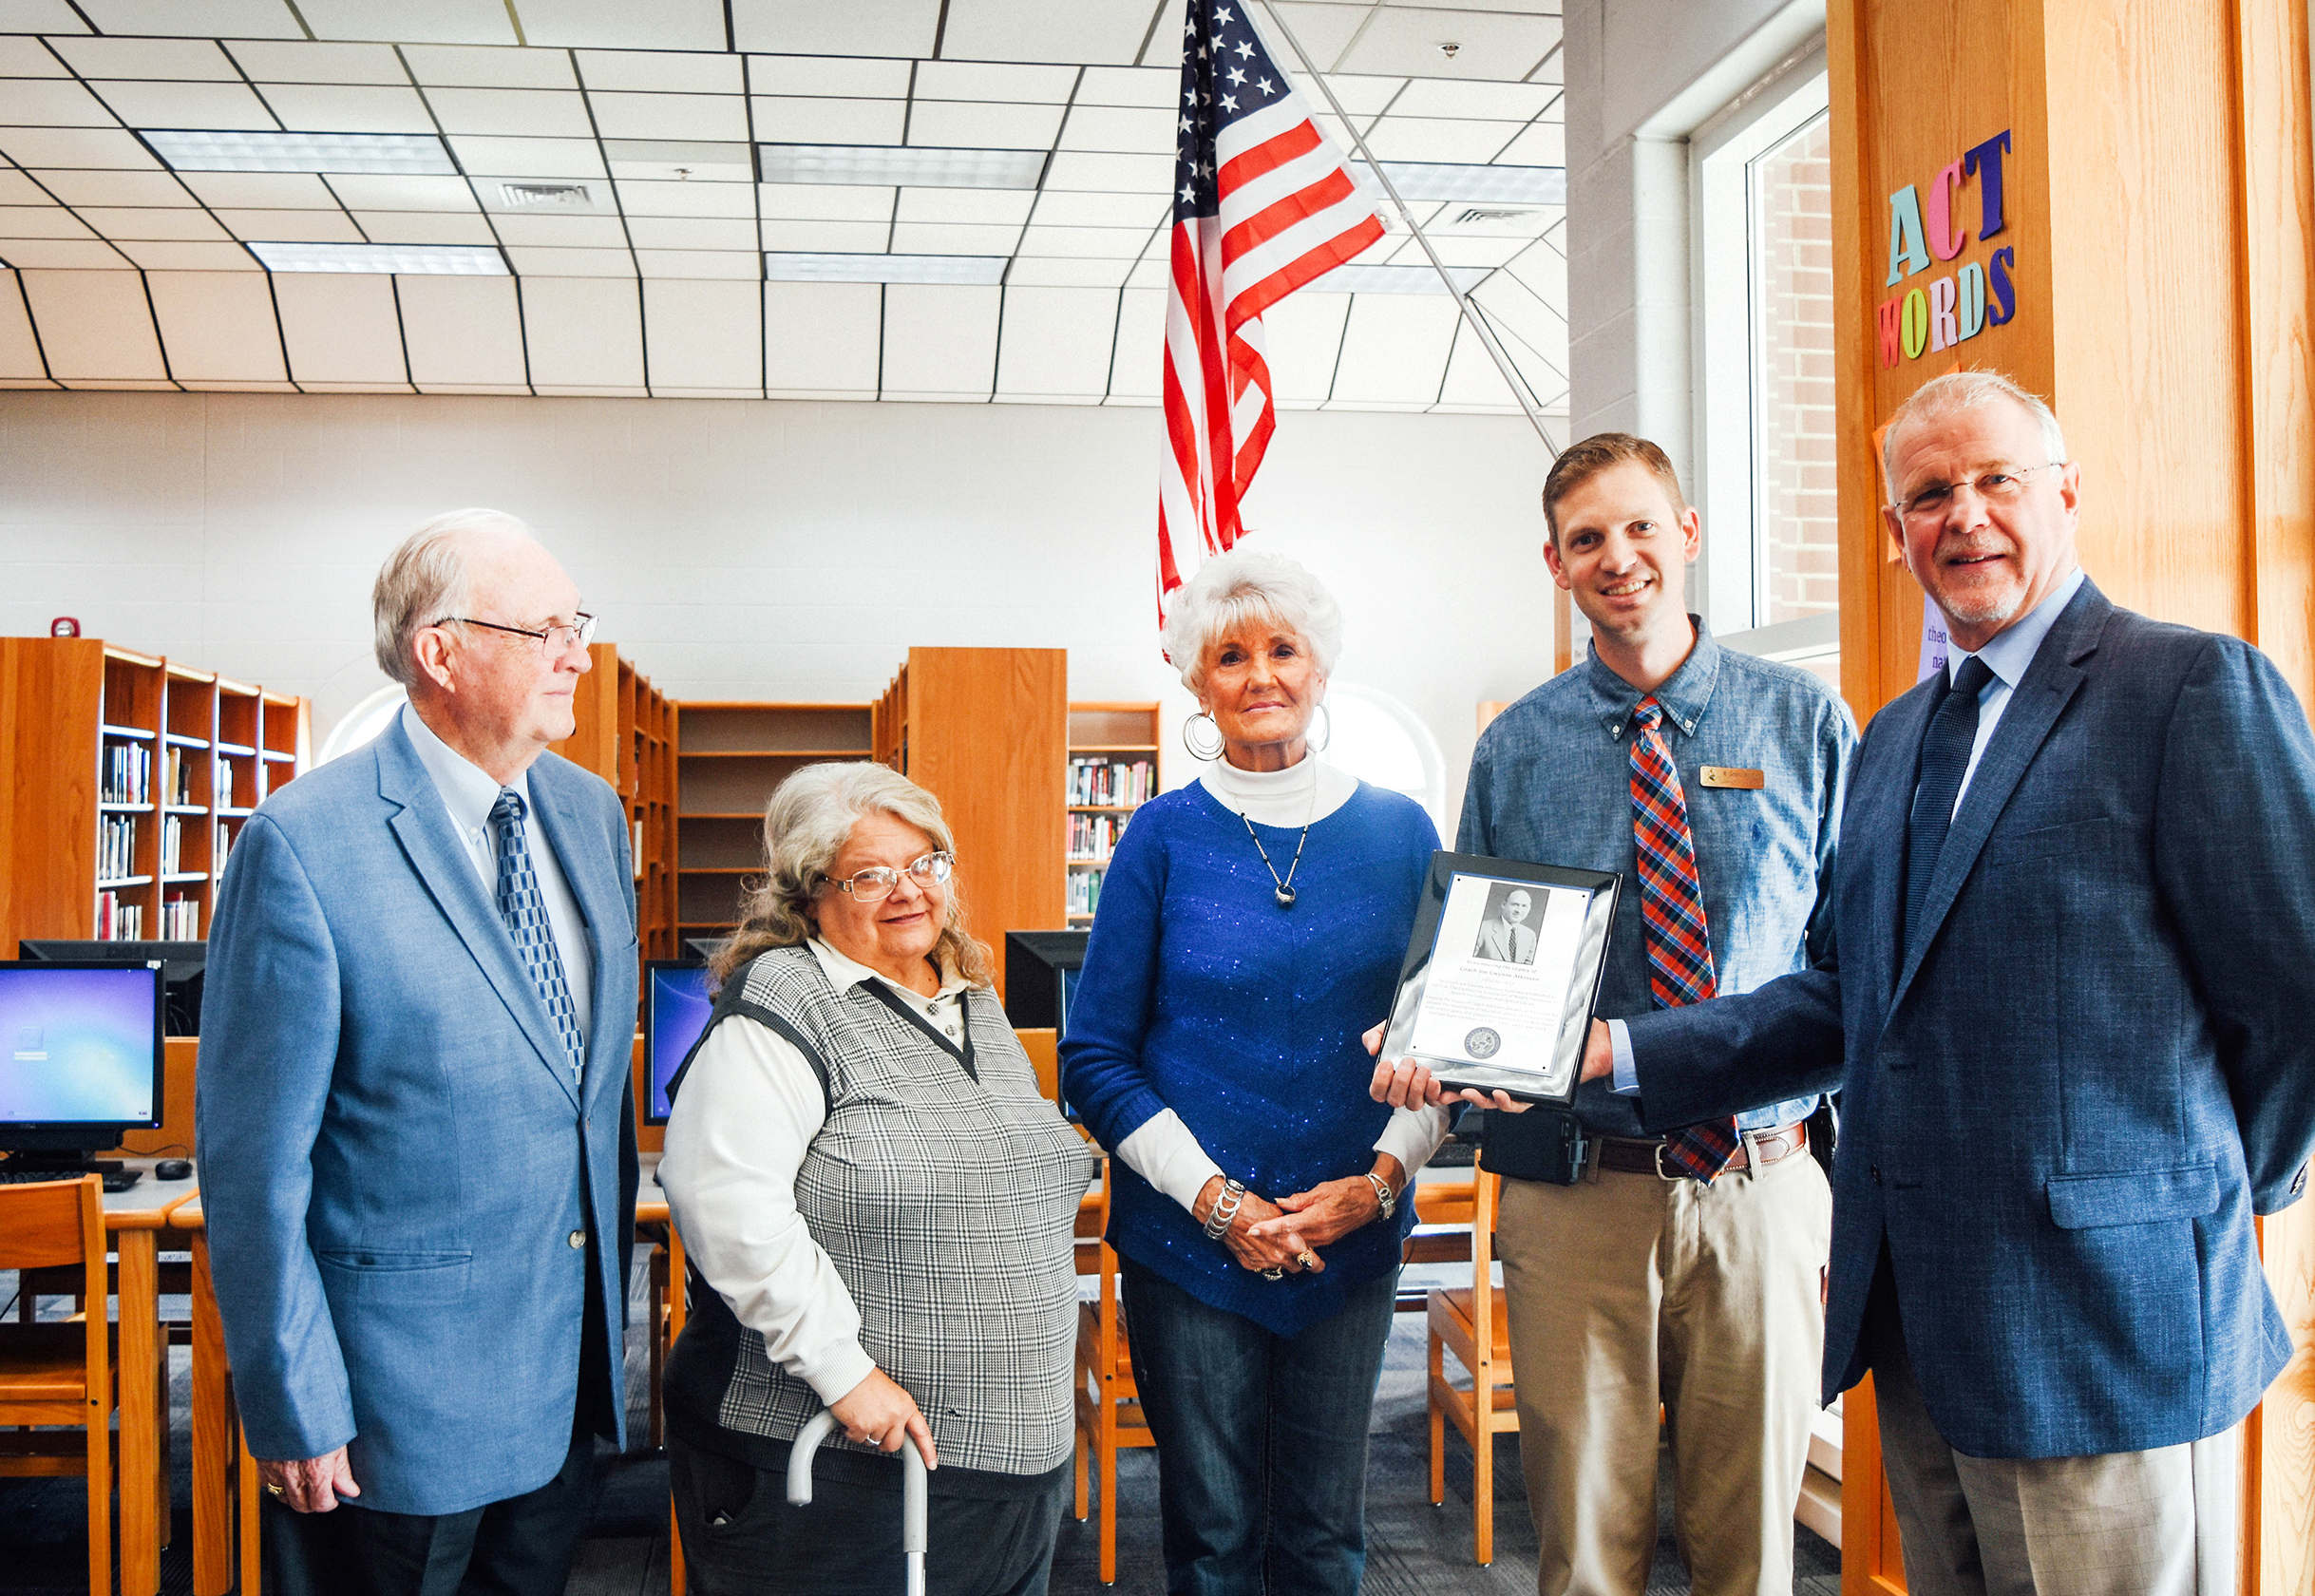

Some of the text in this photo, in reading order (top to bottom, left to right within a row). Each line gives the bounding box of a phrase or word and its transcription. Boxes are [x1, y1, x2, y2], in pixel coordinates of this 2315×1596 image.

[1887, 128, 2011, 287] ACT
[1878, 245, 2016, 370] WORDS
[1513, 973, 1540, 982] Atkinson
